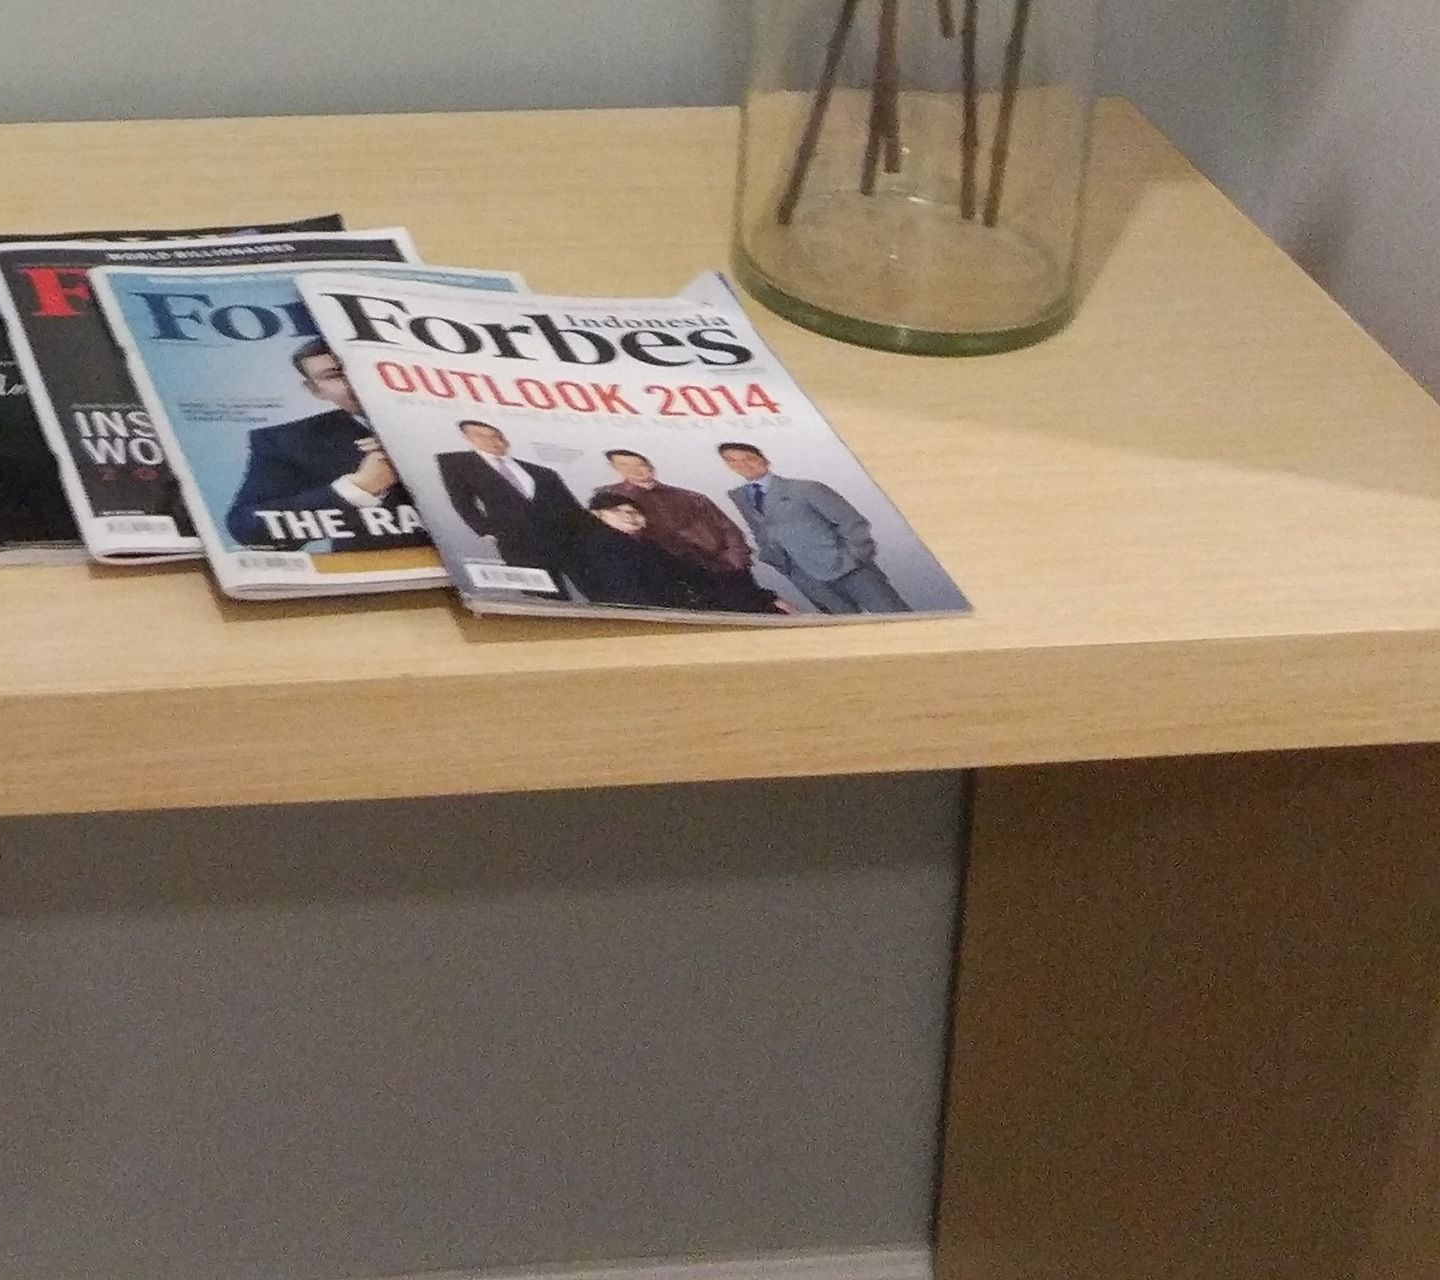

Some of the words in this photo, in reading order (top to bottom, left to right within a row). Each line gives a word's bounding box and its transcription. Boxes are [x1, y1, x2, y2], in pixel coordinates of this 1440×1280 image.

[320, 293, 754, 367] Forbes
[564, 313, 731, 329] Indonesia
[375, 360, 641, 414] OUTLOOK
[646, 383, 782, 417] 2014
[254, 508, 357, 540] THE
[360, 504, 426, 536] RA
